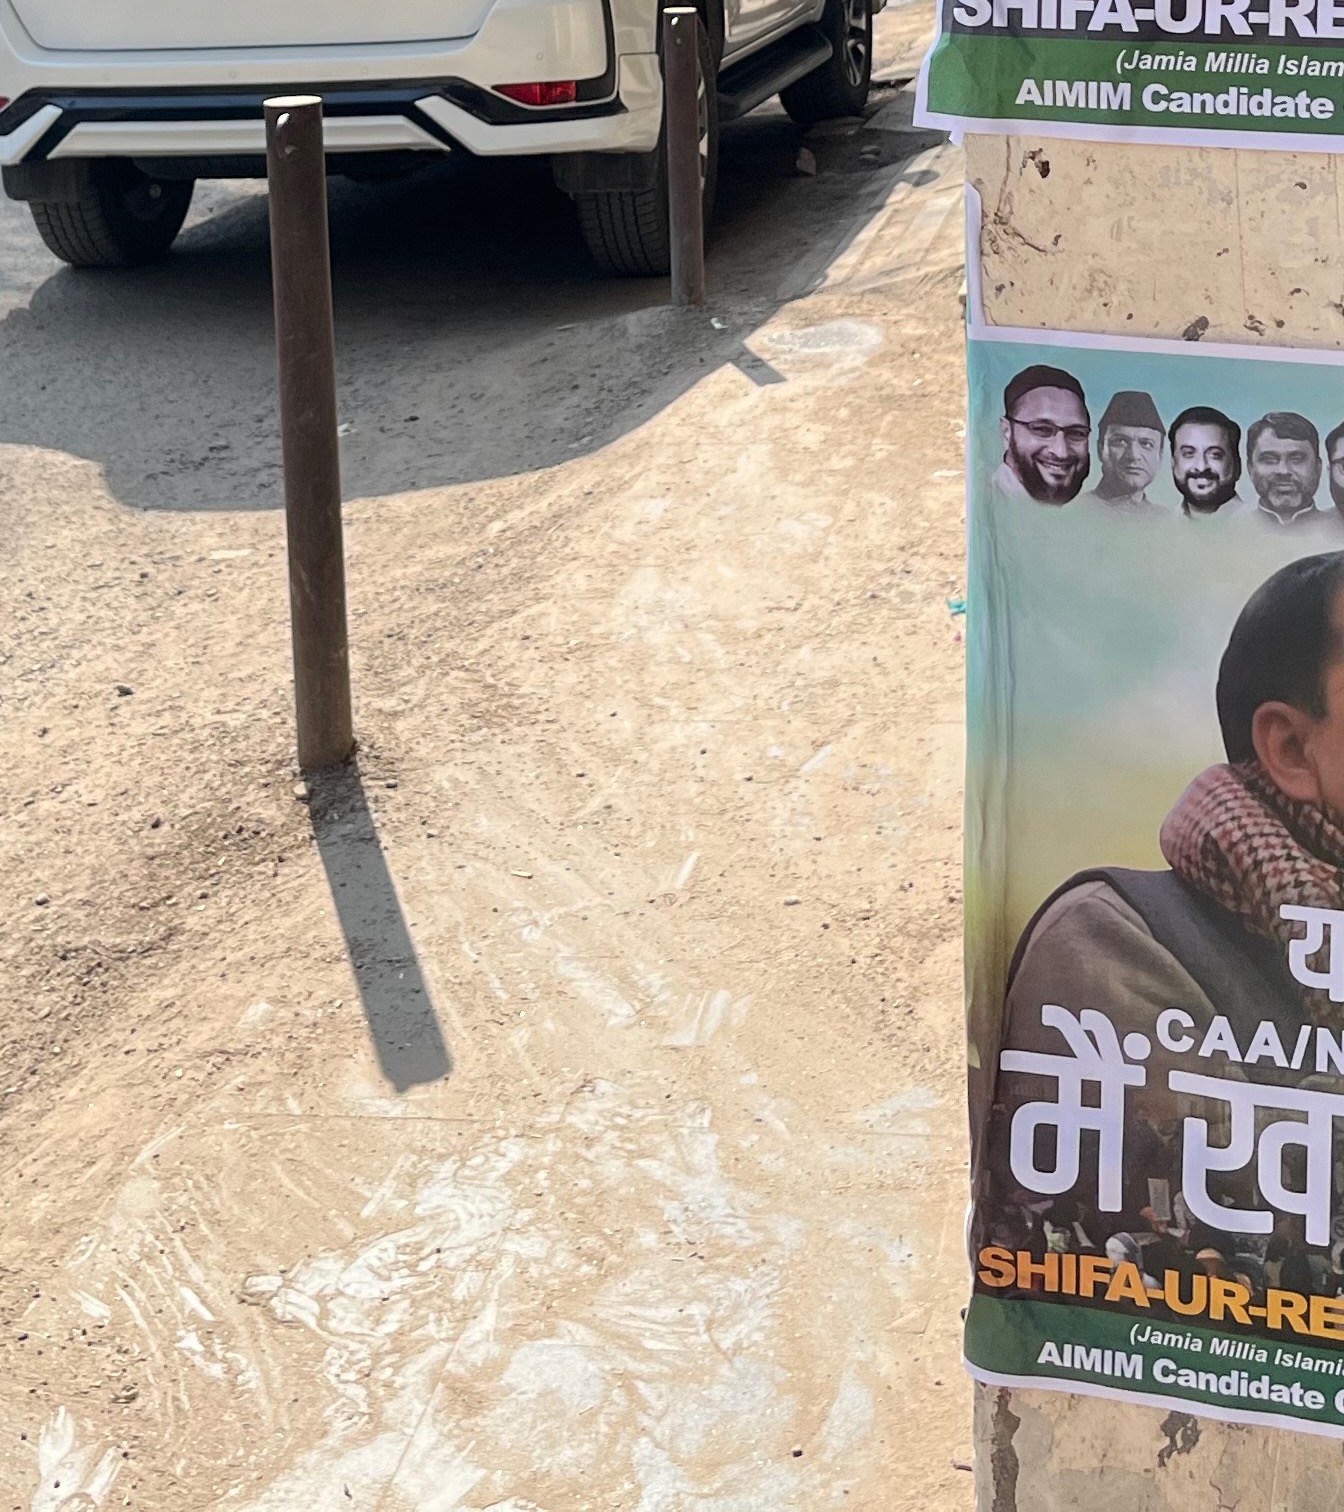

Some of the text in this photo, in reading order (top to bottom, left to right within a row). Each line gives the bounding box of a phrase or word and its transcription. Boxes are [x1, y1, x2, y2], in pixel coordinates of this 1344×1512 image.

[1115, 49, 1197, 76] (Jamia
[1204, 51, 1270, 75] Millia
[1015, 78, 1132, 111] AIMIM
[1142, 83, 1335, 119] Candidate
[1000, 1004, 1152, 1213] मैं
[1129, 1323, 1203, 1353] (Jamia
[1209, 1337, 1268, 1364] Millia
[1037, 1341, 1143, 1380] AIMIM
[1152, 1353, 1325, 1410] Candidate
